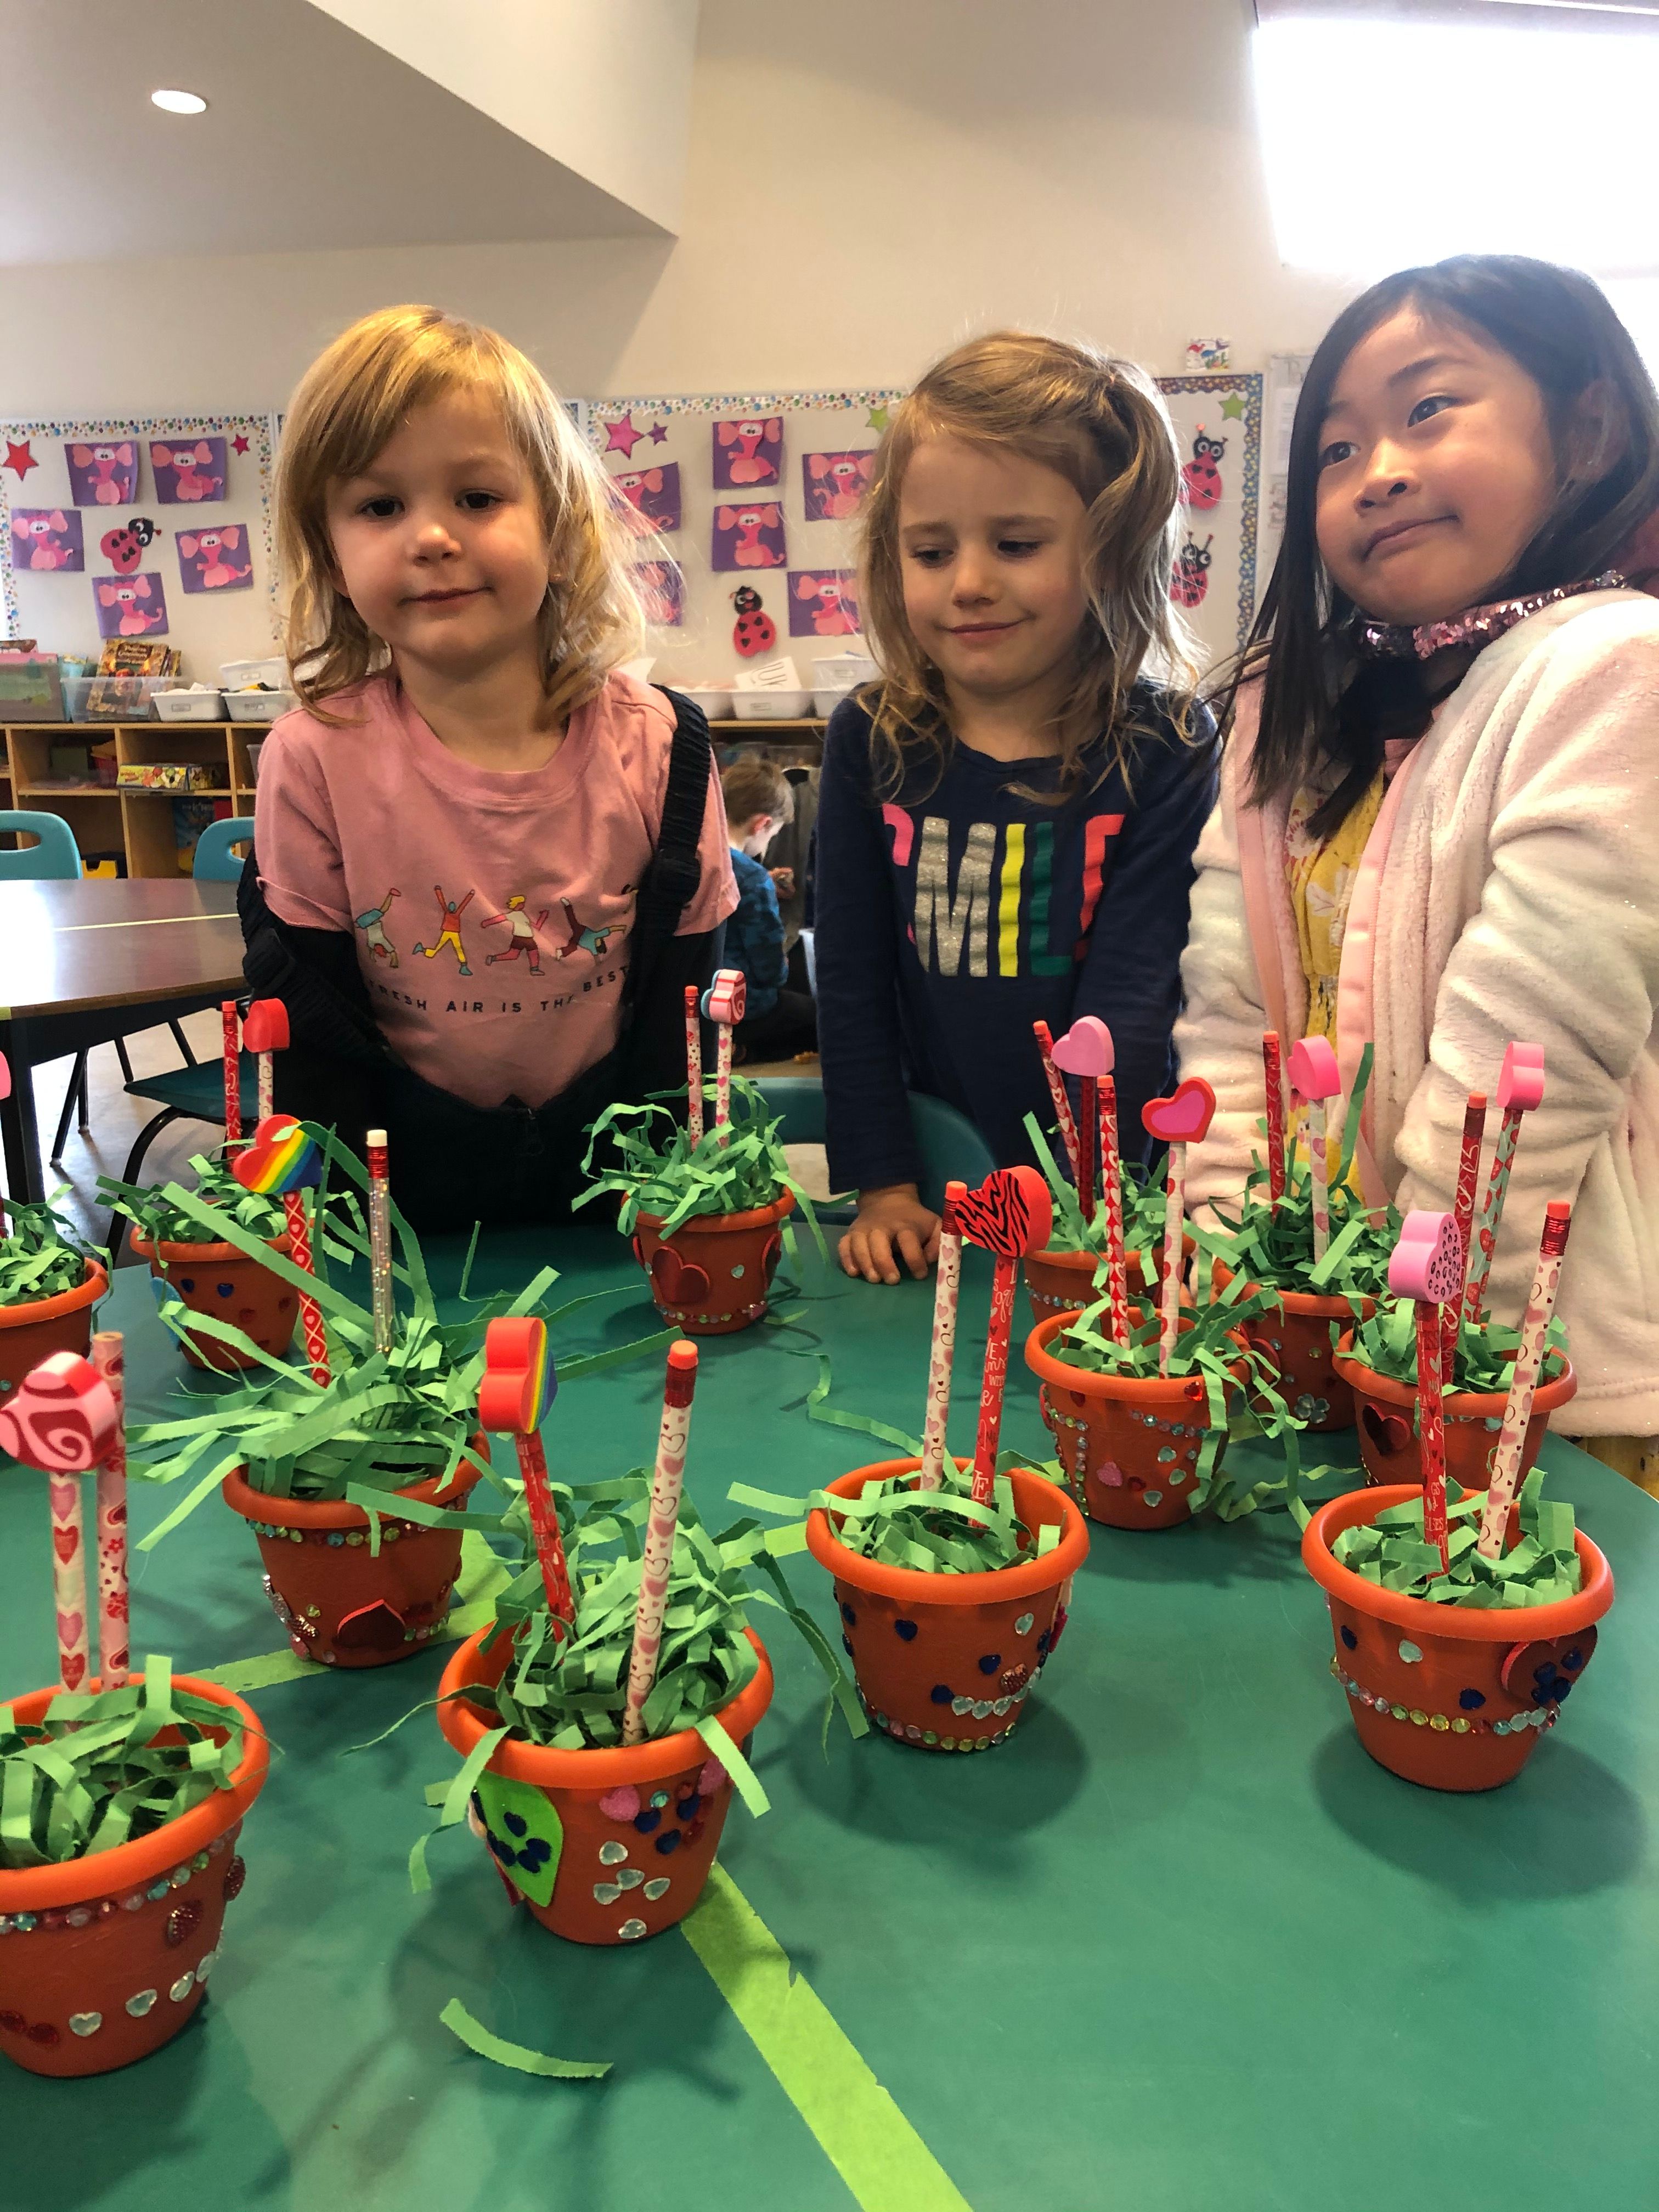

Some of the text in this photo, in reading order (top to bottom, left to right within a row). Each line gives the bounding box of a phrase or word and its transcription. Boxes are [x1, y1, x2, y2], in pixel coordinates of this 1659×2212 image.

[882, 803, 1126, 977] MIL
[445, 1001, 483, 1012] AIR
[502, 1002, 522, 1013] IS
[583, 966, 628, 992] BEST
